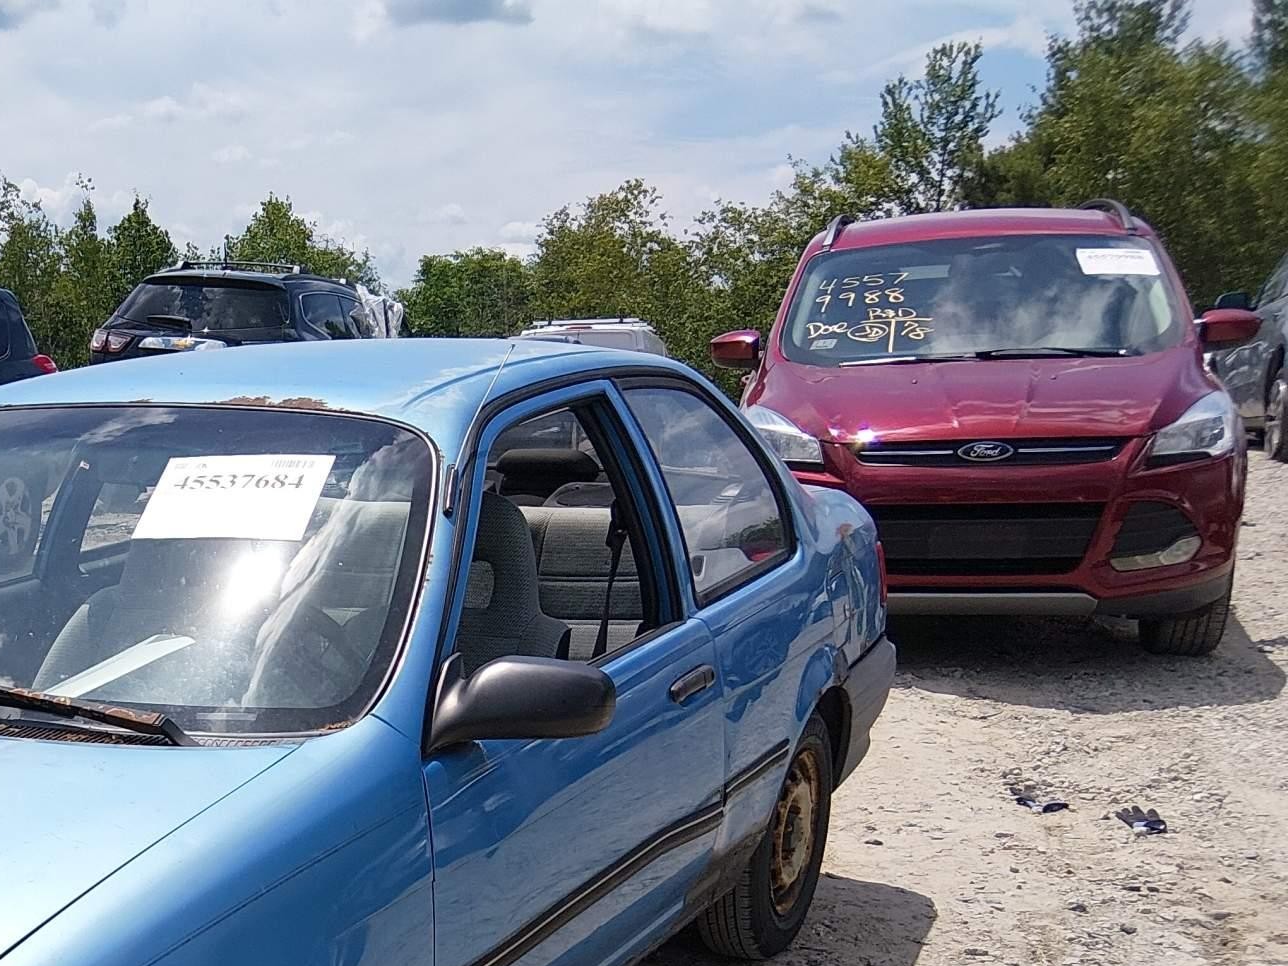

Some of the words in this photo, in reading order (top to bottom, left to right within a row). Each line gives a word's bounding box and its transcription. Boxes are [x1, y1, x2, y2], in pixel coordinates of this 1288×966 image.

[819, 272, 909, 294] 4557
[816, 287, 905, 313] 9988
[970, 444, 1002, 457] Ford
[173, 474, 305, 490] 45537684
